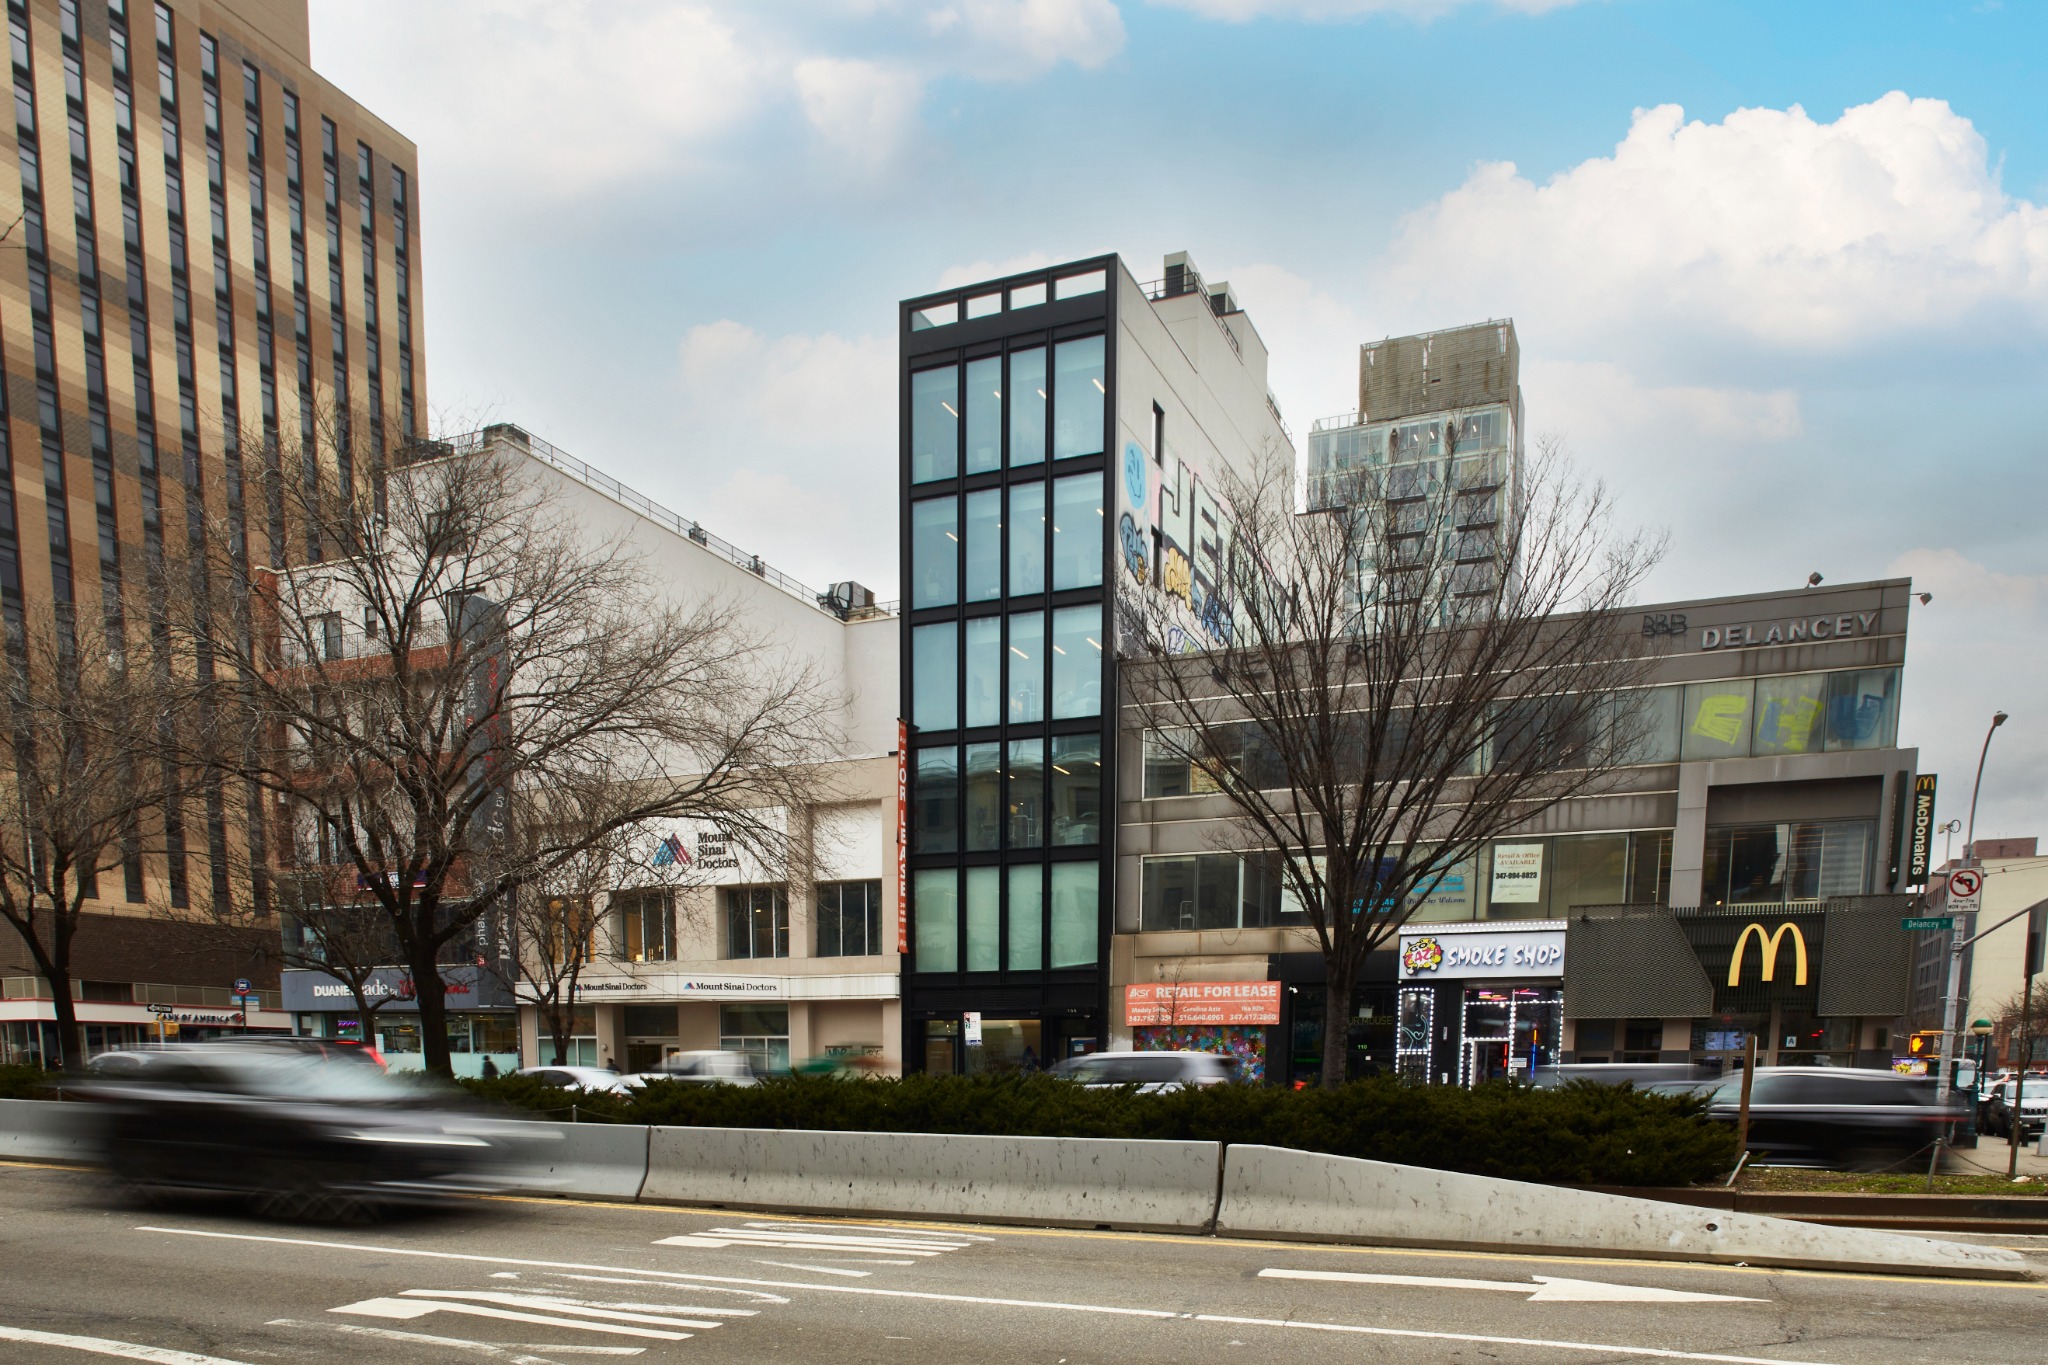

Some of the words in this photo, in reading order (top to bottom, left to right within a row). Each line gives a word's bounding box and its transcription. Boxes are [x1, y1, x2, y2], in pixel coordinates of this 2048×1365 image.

[1702, 612, 1878, 649] DELANCEY
[899, 750, 907, 802] FOR
[698, 831, 733, 843] Mount
[1912, 795, 1931, 875] McDonald's
[698, 843, 726, 857] Sinai
[899, 810, 907, 897] LEASE
[698, 858, 738, 869] Doctors
[1908, 920, 1939, 929] Delancey
[1448, 944, 1507, 966] SMOKE
[1513, 943, 1562, 967] SHOP
[313, 985, 349, 997] DUANE
[696, 982, 723, 990] Mount
[724, 982, 745, 990] Sinai
[746, 983, 777, 991] Doctors
[1156, 986, 1201, 998] RETAIL
[1204, 986, 1231, 997] FOR
[1234, 985, 1276, 997] LEASE
[193, 1014, 230, 1022] AMERICA
